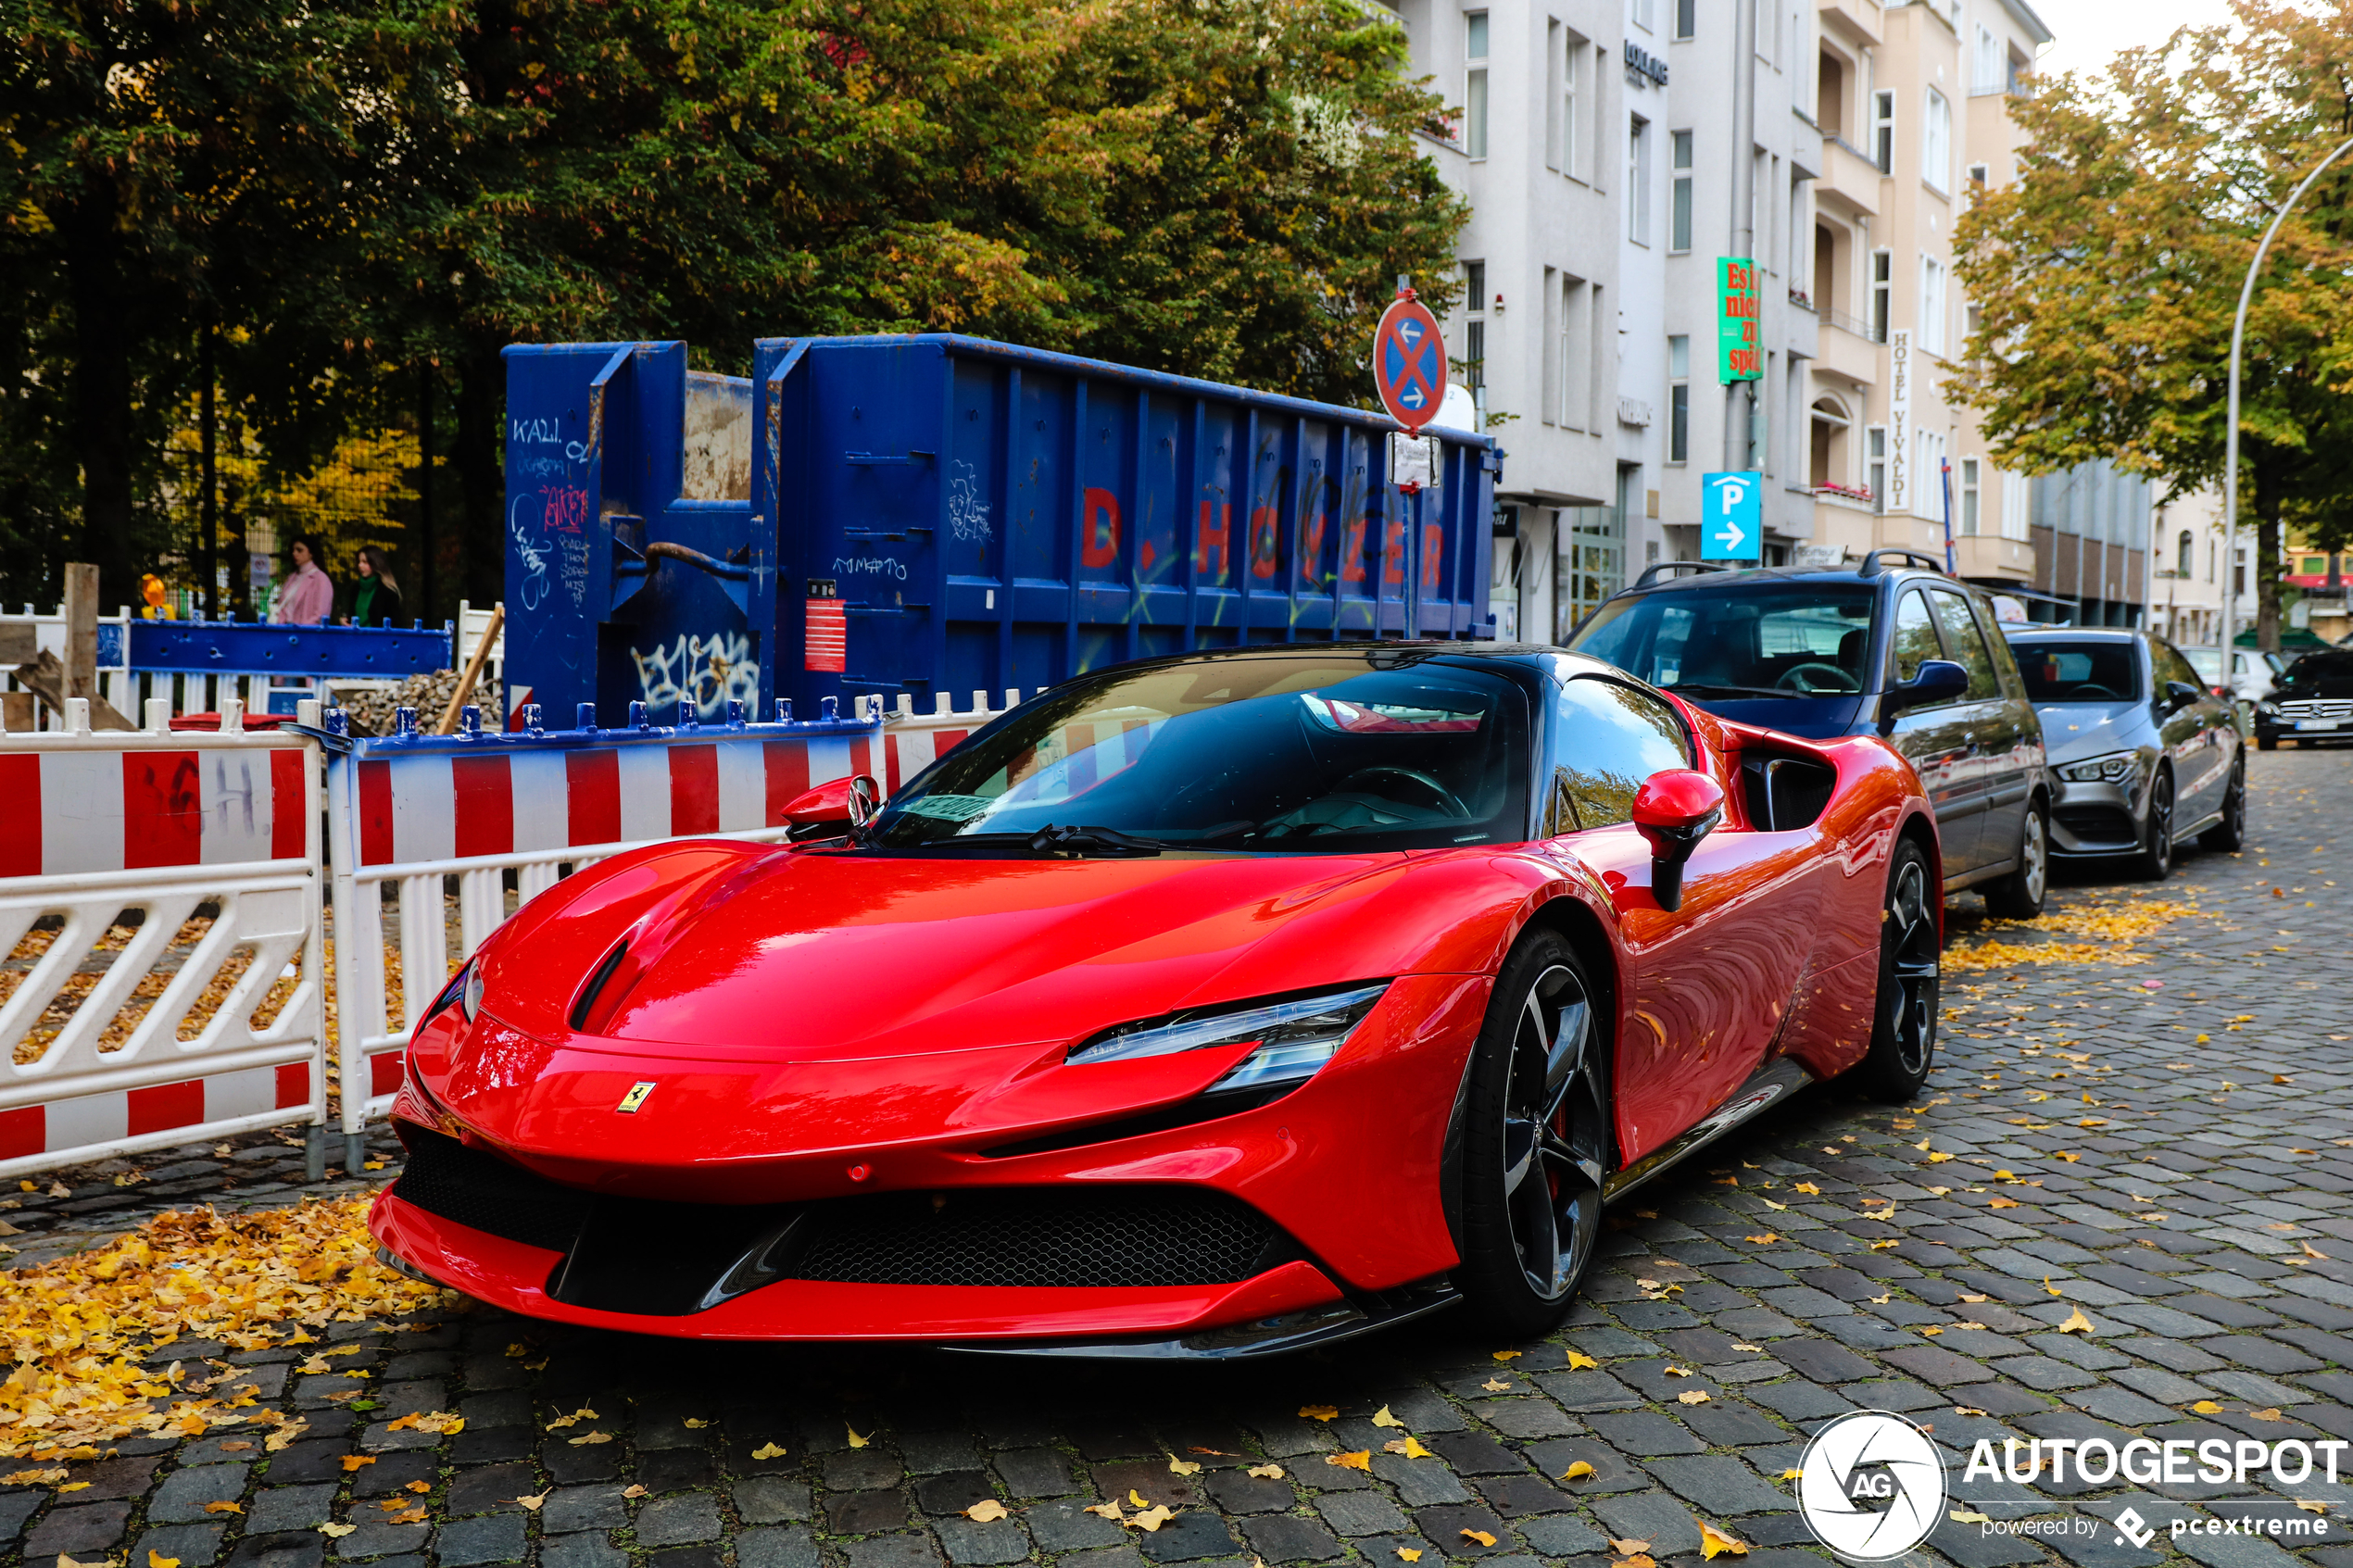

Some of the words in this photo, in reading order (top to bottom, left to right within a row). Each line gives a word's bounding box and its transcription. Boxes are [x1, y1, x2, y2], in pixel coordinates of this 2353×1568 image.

[1727, 263, 1747, 289] Es
[1894, 333, 1906, 402] HOTEL
[1892, 410, 1906, 506] VIVALDI
[1722, 484, 1744, 515] P
[1197, 500, 1445, 588] HOYZER
